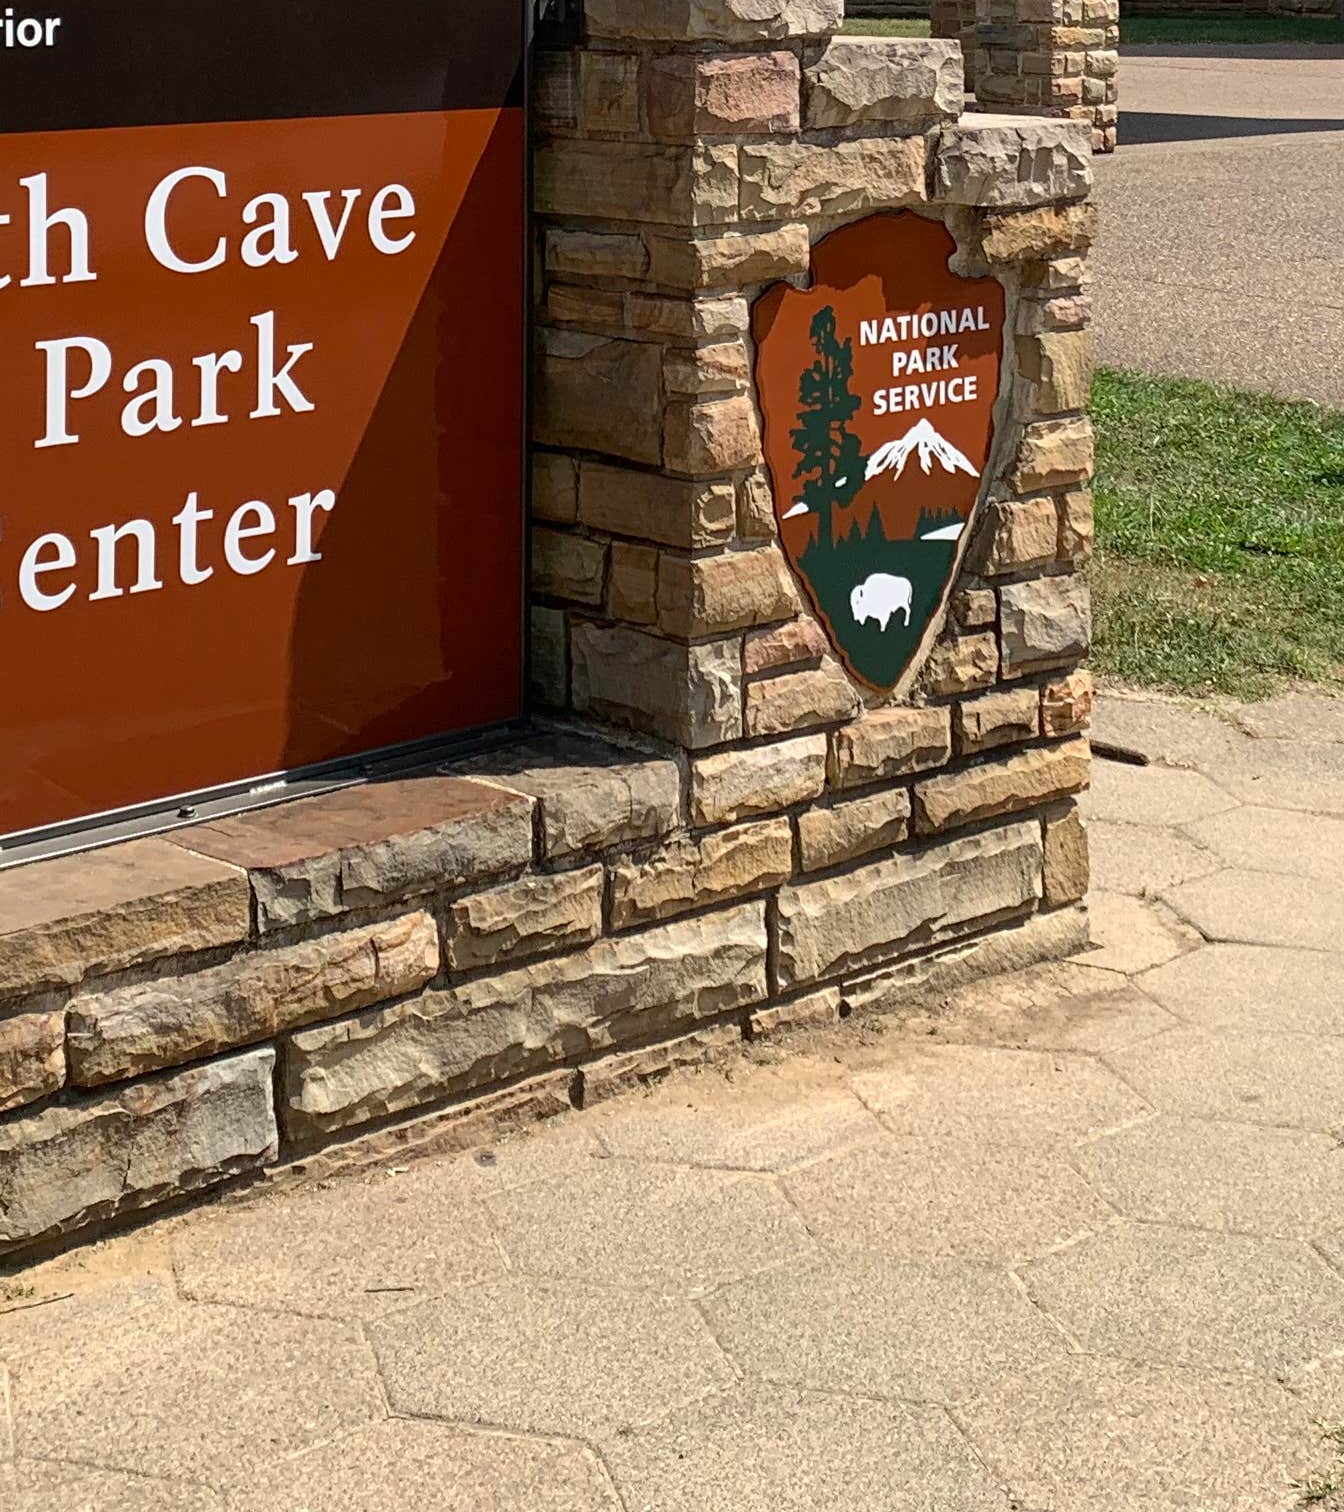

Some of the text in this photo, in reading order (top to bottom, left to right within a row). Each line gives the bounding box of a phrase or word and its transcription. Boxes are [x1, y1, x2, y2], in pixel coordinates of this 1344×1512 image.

[144, 165, 416, 274] Cave
[859, 305, 991, 347] NATIONAL
[34, 309, 315, 449] Park
[891, 344, 960, 377] PARK
[872, 375, 978, 416] SERVICE
